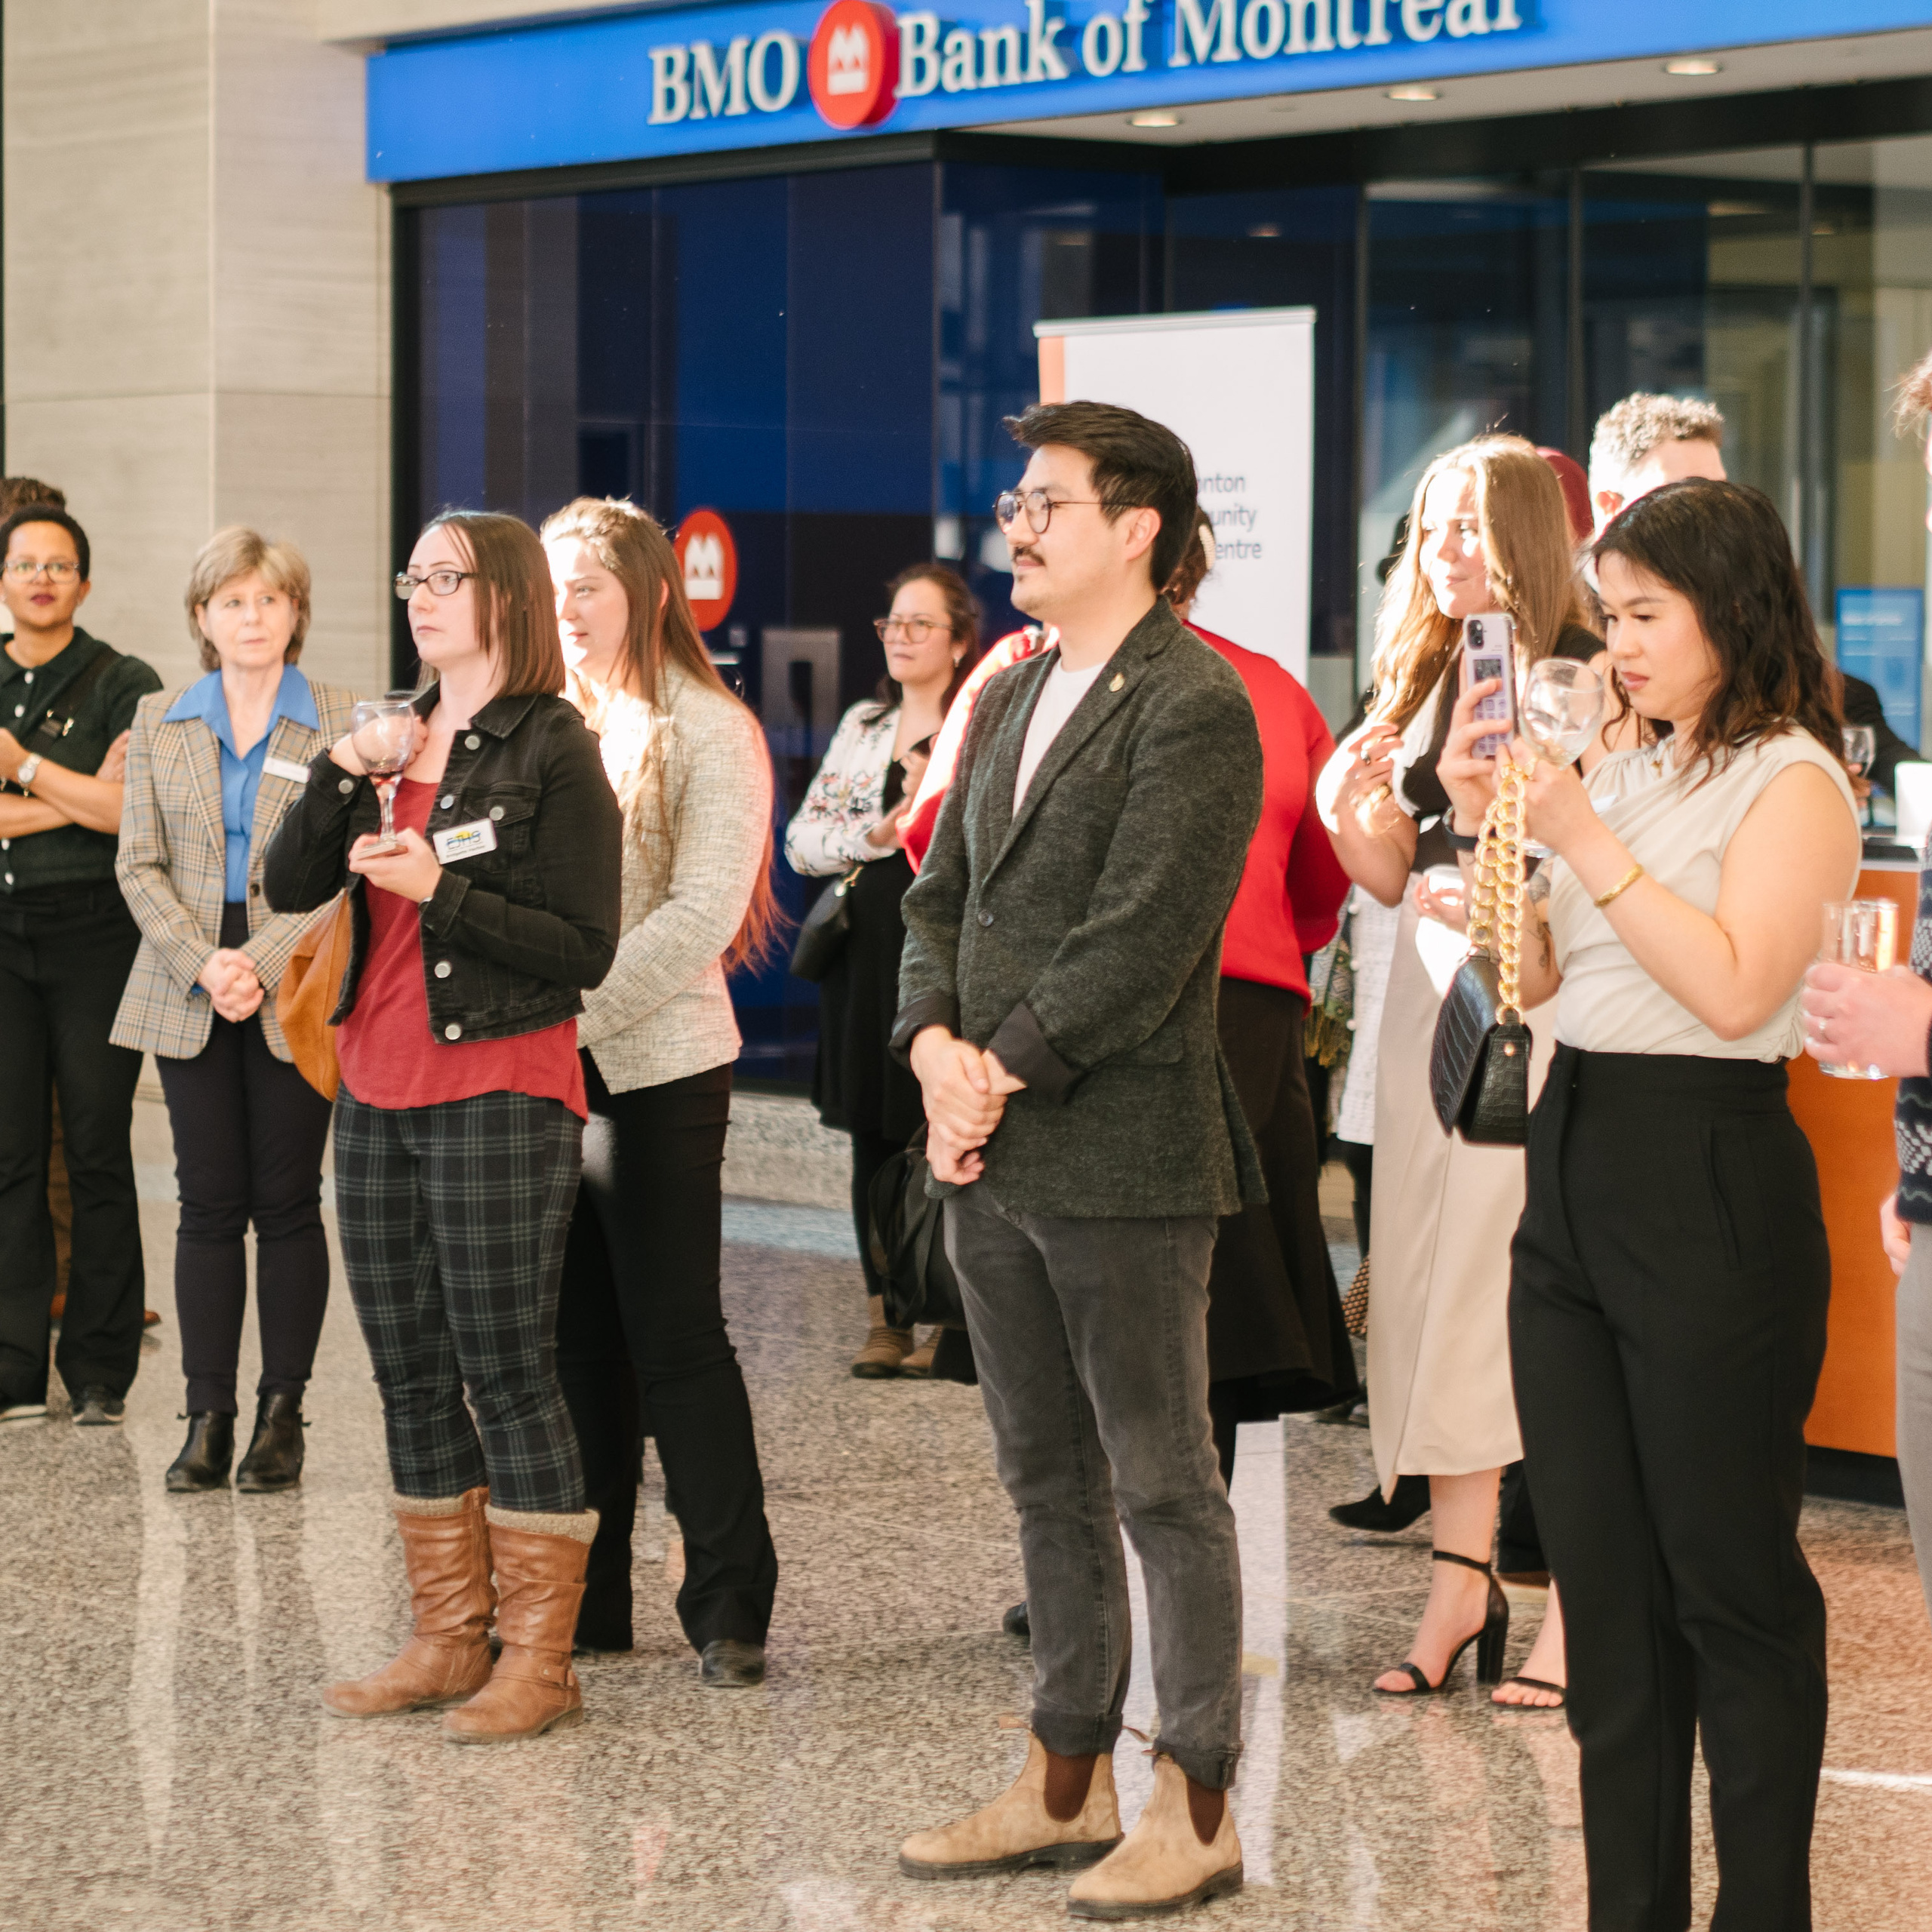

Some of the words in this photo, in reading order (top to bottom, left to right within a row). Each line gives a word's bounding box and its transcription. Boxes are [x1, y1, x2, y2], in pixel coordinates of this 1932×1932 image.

[648, 31, 801, 125] BMO
[894, 0, 1070, 99] Bank
[1082, 0, 1150, 77] of
